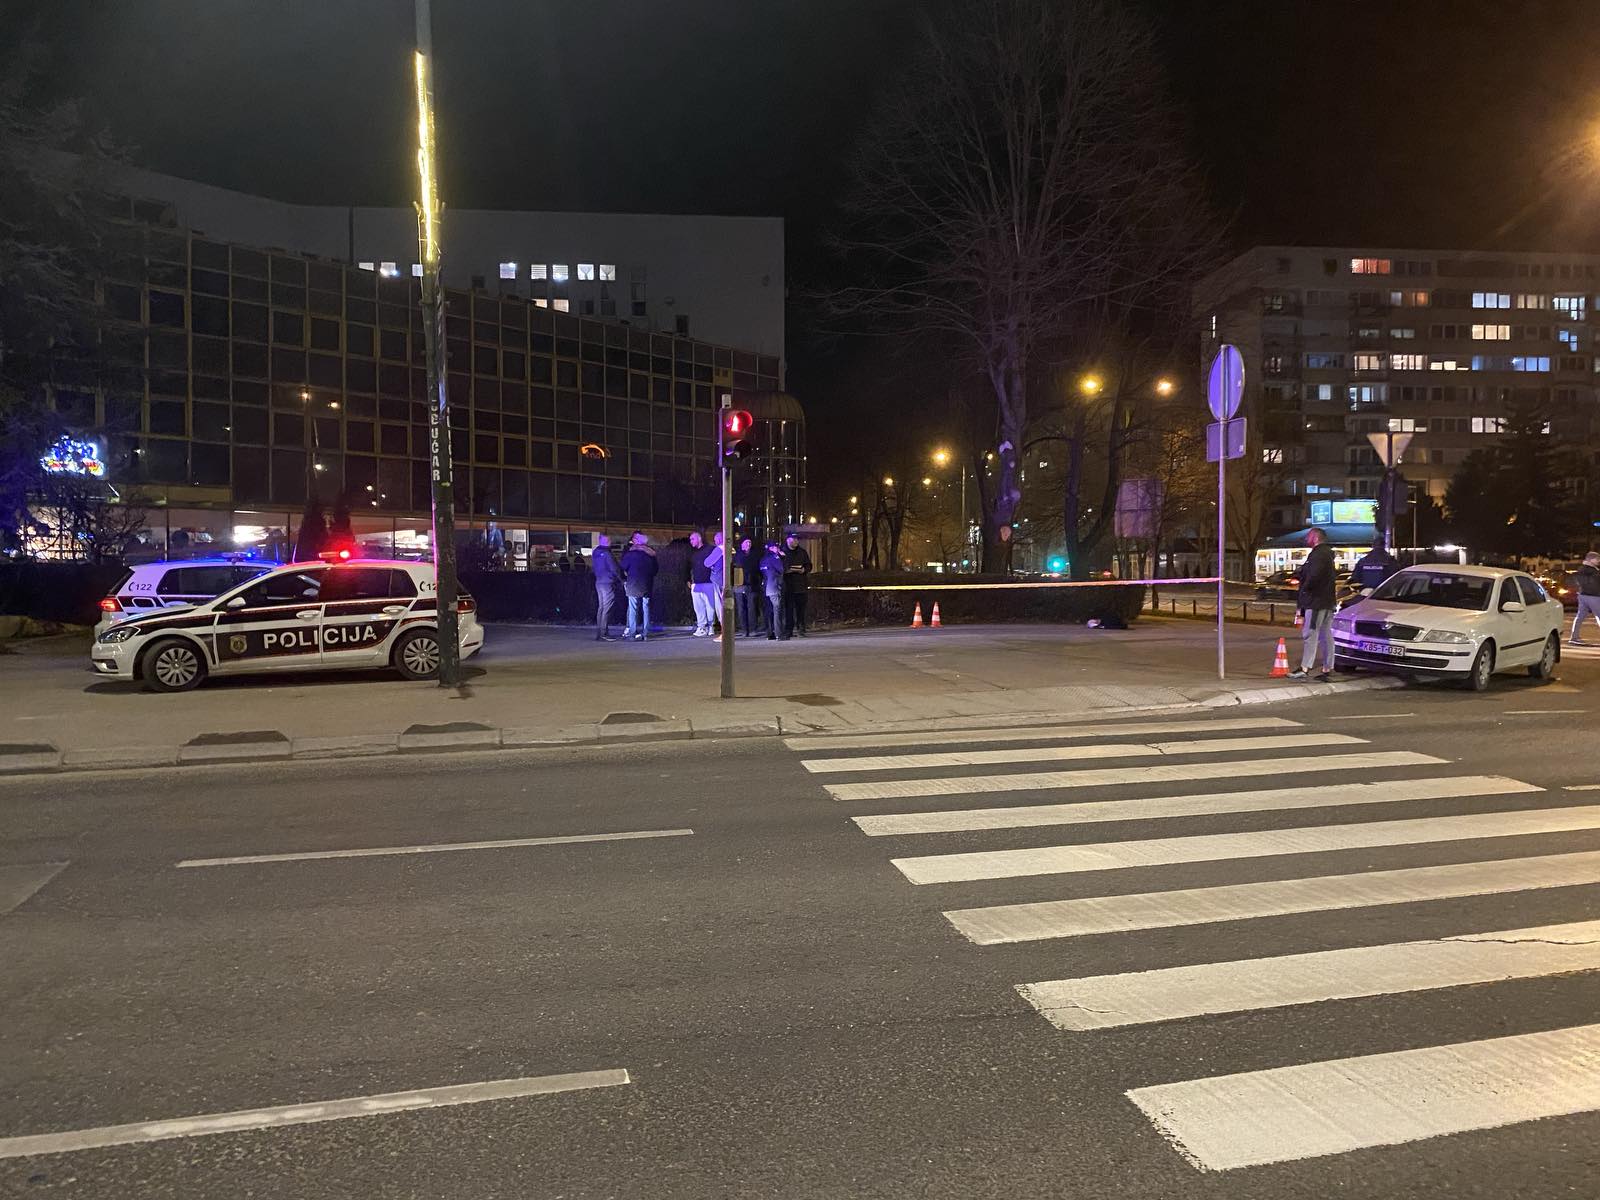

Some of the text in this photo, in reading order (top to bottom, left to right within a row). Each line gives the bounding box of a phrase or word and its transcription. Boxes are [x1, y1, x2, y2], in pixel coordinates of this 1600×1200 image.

[136, 583, 152, 591] 122
[427, 583, 437, 591] 12
[263, 625, 377, 649] POLICIJA
